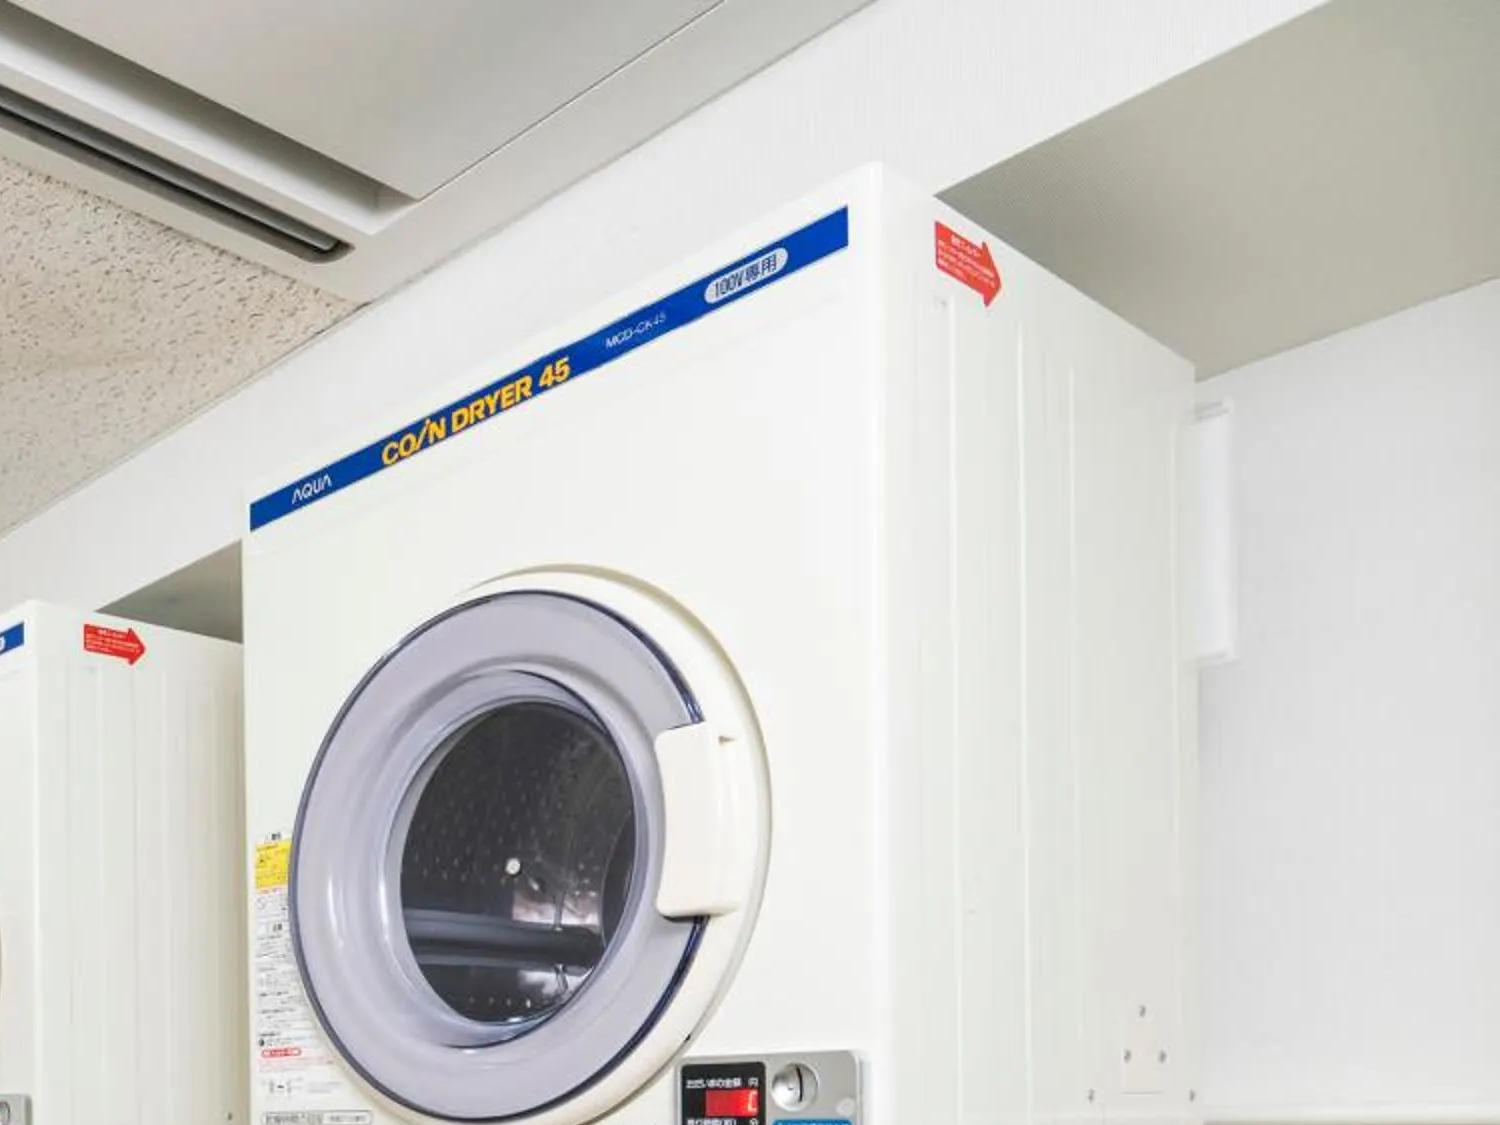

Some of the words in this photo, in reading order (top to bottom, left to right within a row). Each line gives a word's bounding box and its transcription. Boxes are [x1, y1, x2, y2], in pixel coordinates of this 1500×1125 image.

[451, 375, 533, 434] DRYER
[538, 356, 571, 389] 45
[291, 473, 333, 504] AQUA
